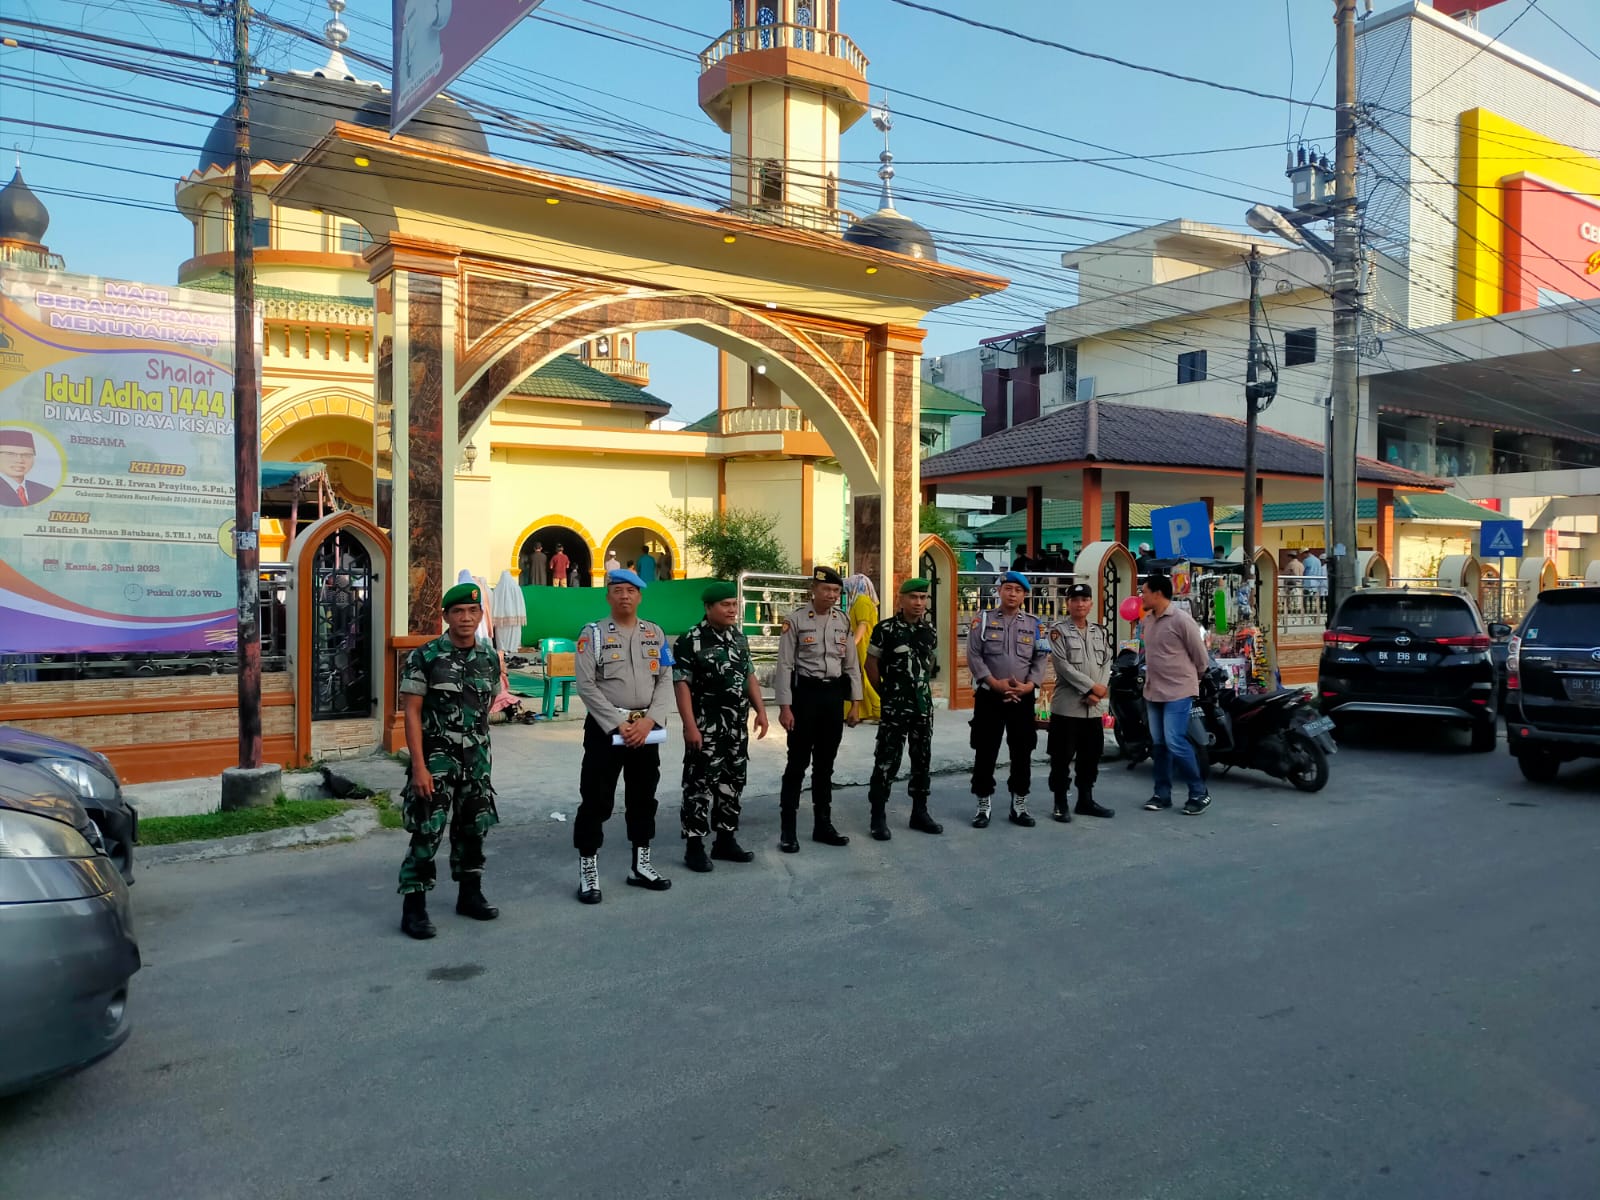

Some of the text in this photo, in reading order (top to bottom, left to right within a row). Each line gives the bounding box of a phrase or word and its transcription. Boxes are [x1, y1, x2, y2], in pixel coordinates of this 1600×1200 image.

[105, 282, 168, 305] MARI
[50, 312, 218, 346] MENUNAIKAN
[146, 358, 215, 387] Shalat
[45, 372, 93, 405] Idul
[98, 378, 163, 413] Adha
[169, 386, 225, 418] 1444
[44, 404, 235, 436] DI MASJID RAYA KISARA
[70, 435, 127, 447] BERSAMA
[128, 461, 187, 476] KHATIB
[72, 476, 96, 485] Prof.
[98, 477, 114, 486] Dr.
[115, 479, 126, 487] H.
[128, 480, 156, 489] Irwan
[158, 482, 200, 492] Prayitno,
[48, 510, 90, 523] IMAM
[36, 525, 47, 533] Al
[81, 528, 119, 536] Rahman
[121, 529, 163, 538] Batubara,
[1168, 518, 1191, 555] P
[65, 562, 99, 572] Kamis,
[115, 564, 134, 573] Juni
[137, 564, 160, 572] 2023
[146, 589, 222, 598] Pukul 07.30 Wib
[1378, 651, 1389, 660] BK
